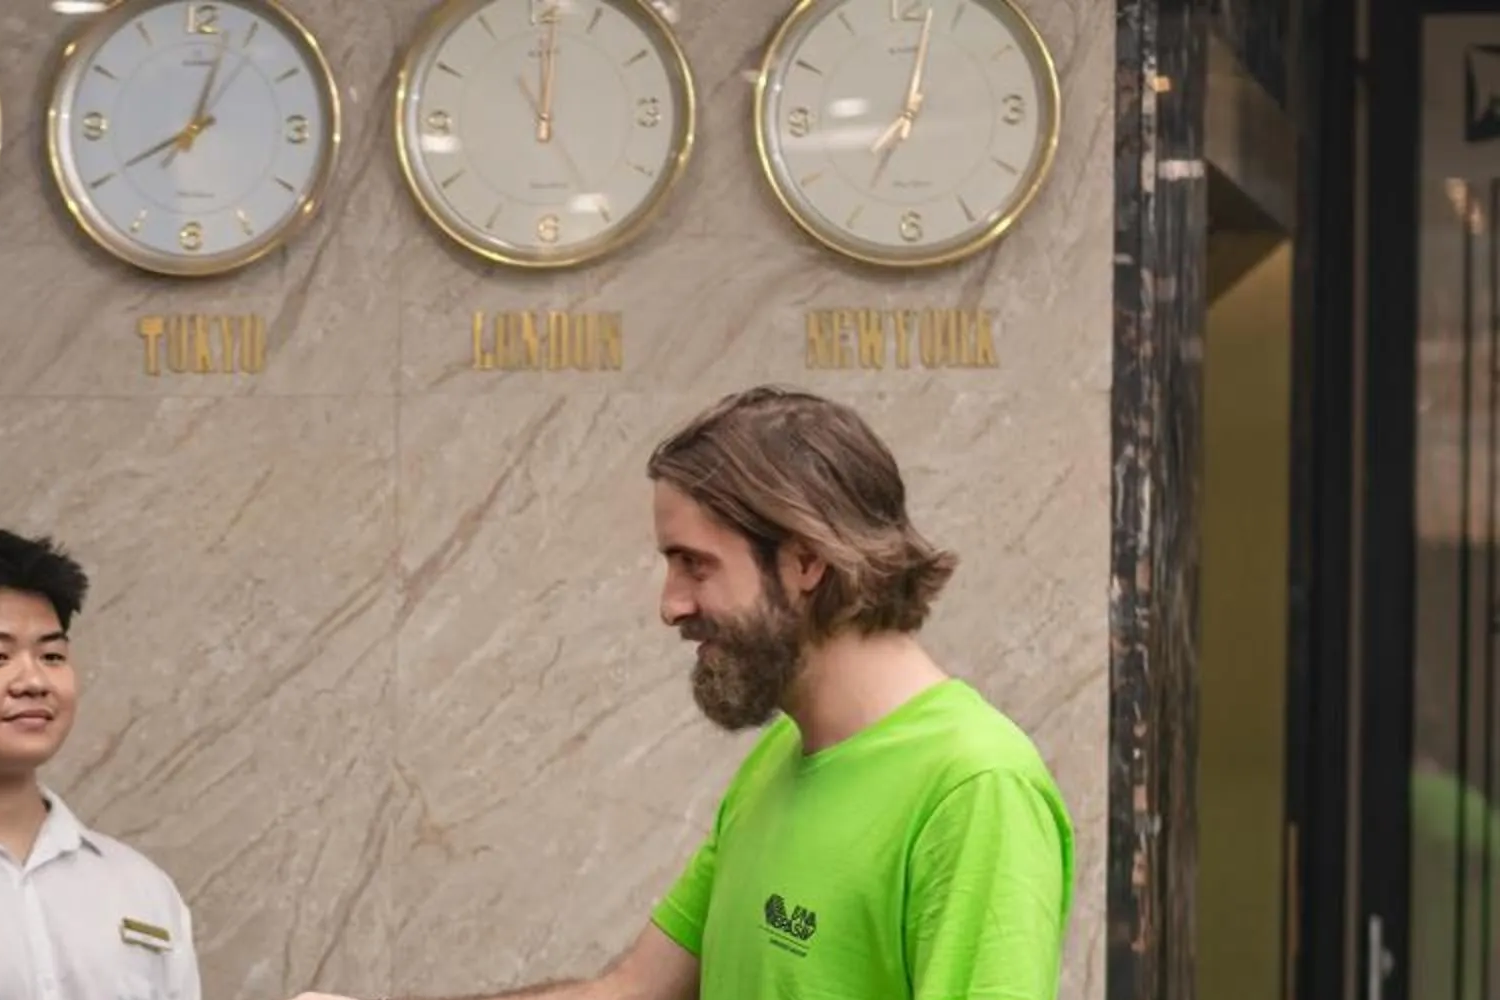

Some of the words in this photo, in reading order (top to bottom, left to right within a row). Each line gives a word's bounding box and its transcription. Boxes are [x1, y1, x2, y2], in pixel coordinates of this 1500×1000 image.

[185, 4, 219, 35] 12
[528, 0, 562, 25] 12
[636, 97, 660, 129] 3
[1002, 94, 1026, 125] 3
[82, 112, 107, 141] 9
[285, 114, 310, 145] 3
[137, 314, 266, 376] TOKYO
[472, 311, 622, 371] LONDON
